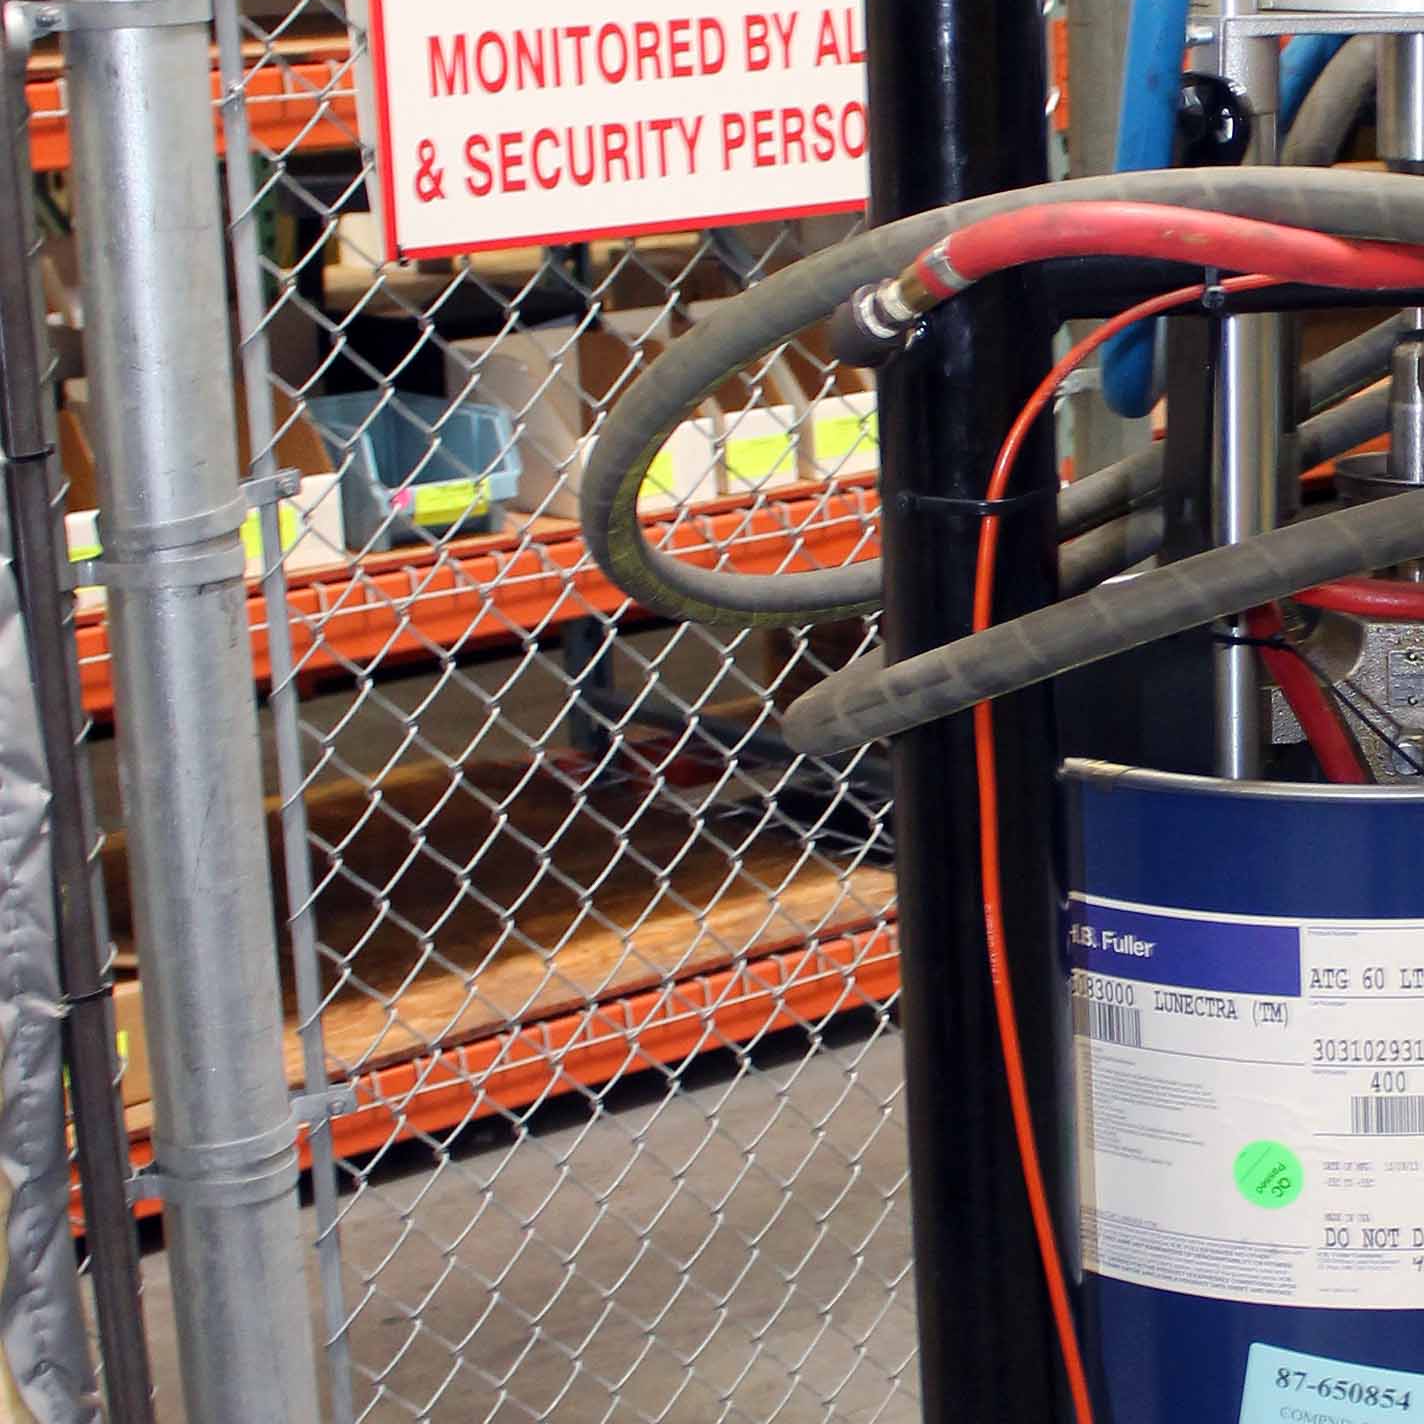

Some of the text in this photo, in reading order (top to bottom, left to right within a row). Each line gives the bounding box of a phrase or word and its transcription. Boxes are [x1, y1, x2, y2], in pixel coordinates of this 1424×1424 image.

[428, 17, 726, 98] MONITORED
[744, 11, 798, 73] BY
[414, 138, 446, 203] &
[464, 115, 703, 197] SECURITY
[1102, 931, 1156, 958] Fuller
[1310, 967, 1349, 990] ATG
[1362, 967, 1385, 990] 60
[1154, 990, 1239, 1020] LUNECTRA
[1252, 1000, 1289, 1028] (TM)
[1370, 1070, 1408, 1094] 400
[1324, 1228, 1350, 1248] DO
[1361, 1228, 1400, 1248] NOT
[1275, 1367, 1412, 1412] 87-650854
